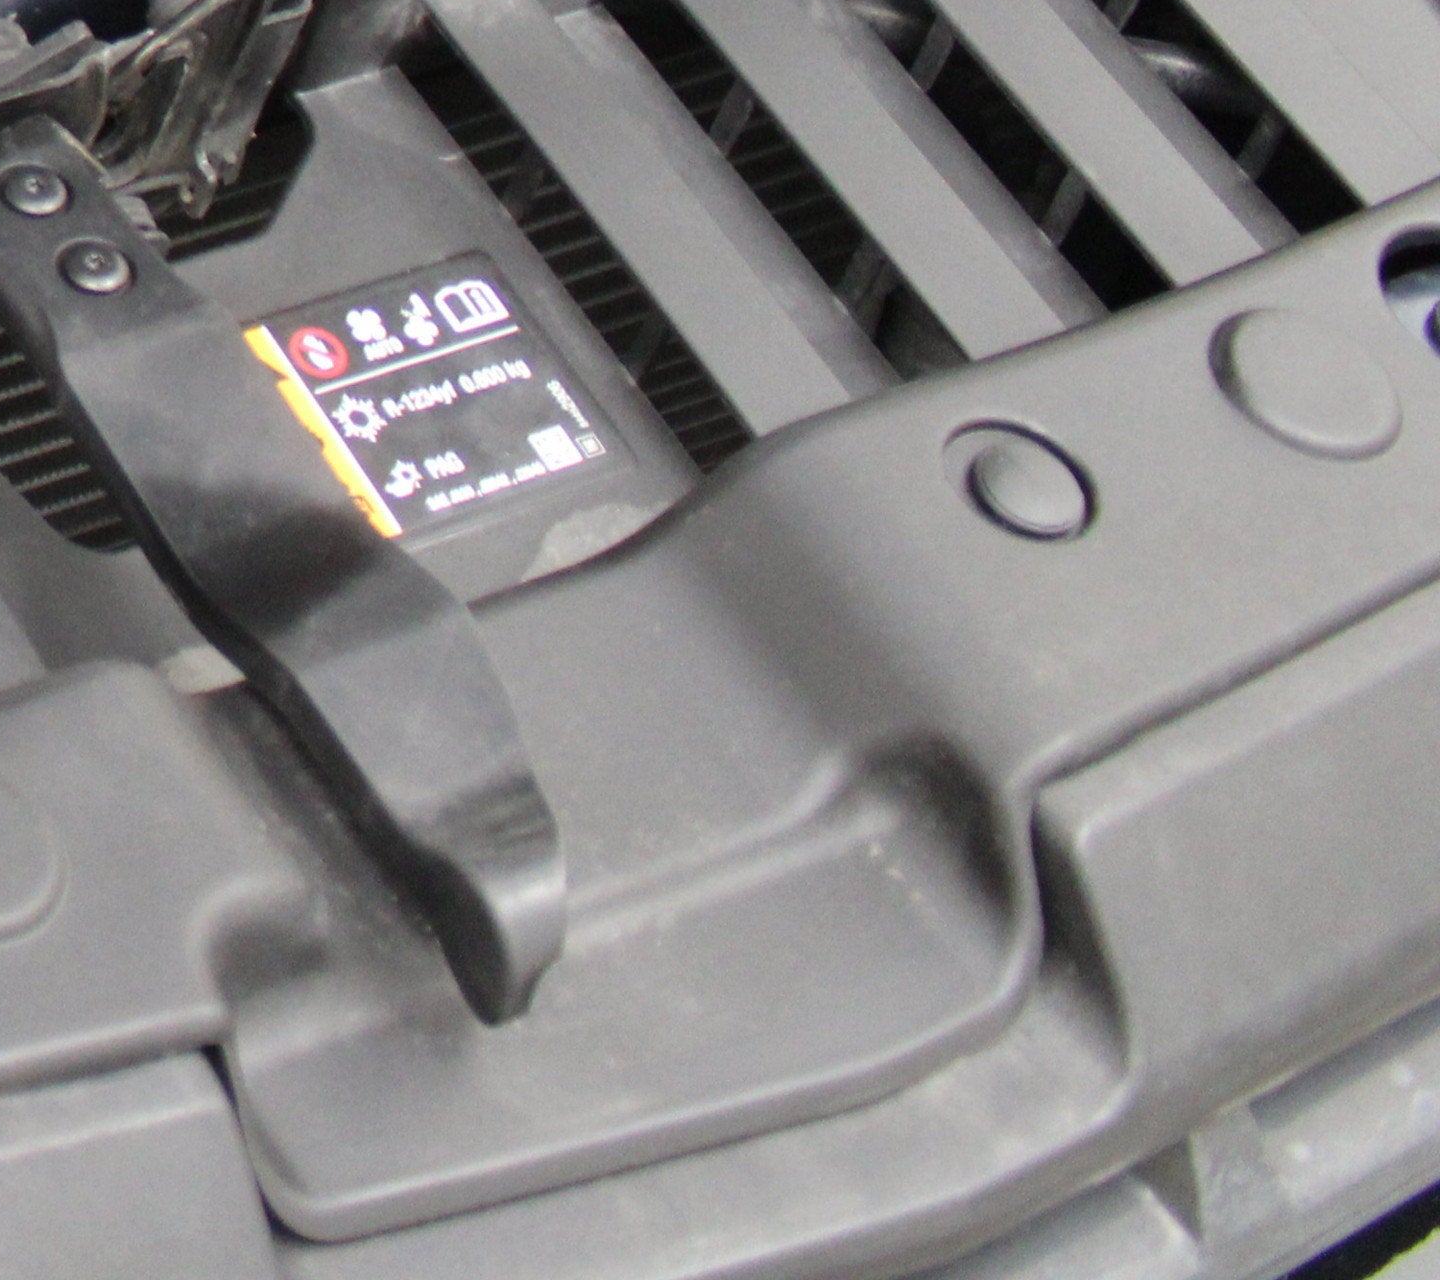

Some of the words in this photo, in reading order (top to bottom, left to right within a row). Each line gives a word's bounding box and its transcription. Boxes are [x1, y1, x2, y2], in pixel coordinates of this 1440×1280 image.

[364, 336, 404, 361] AUTO
[503, 359, 531, 379] kg
[424, 450, 466, 480] PAG
